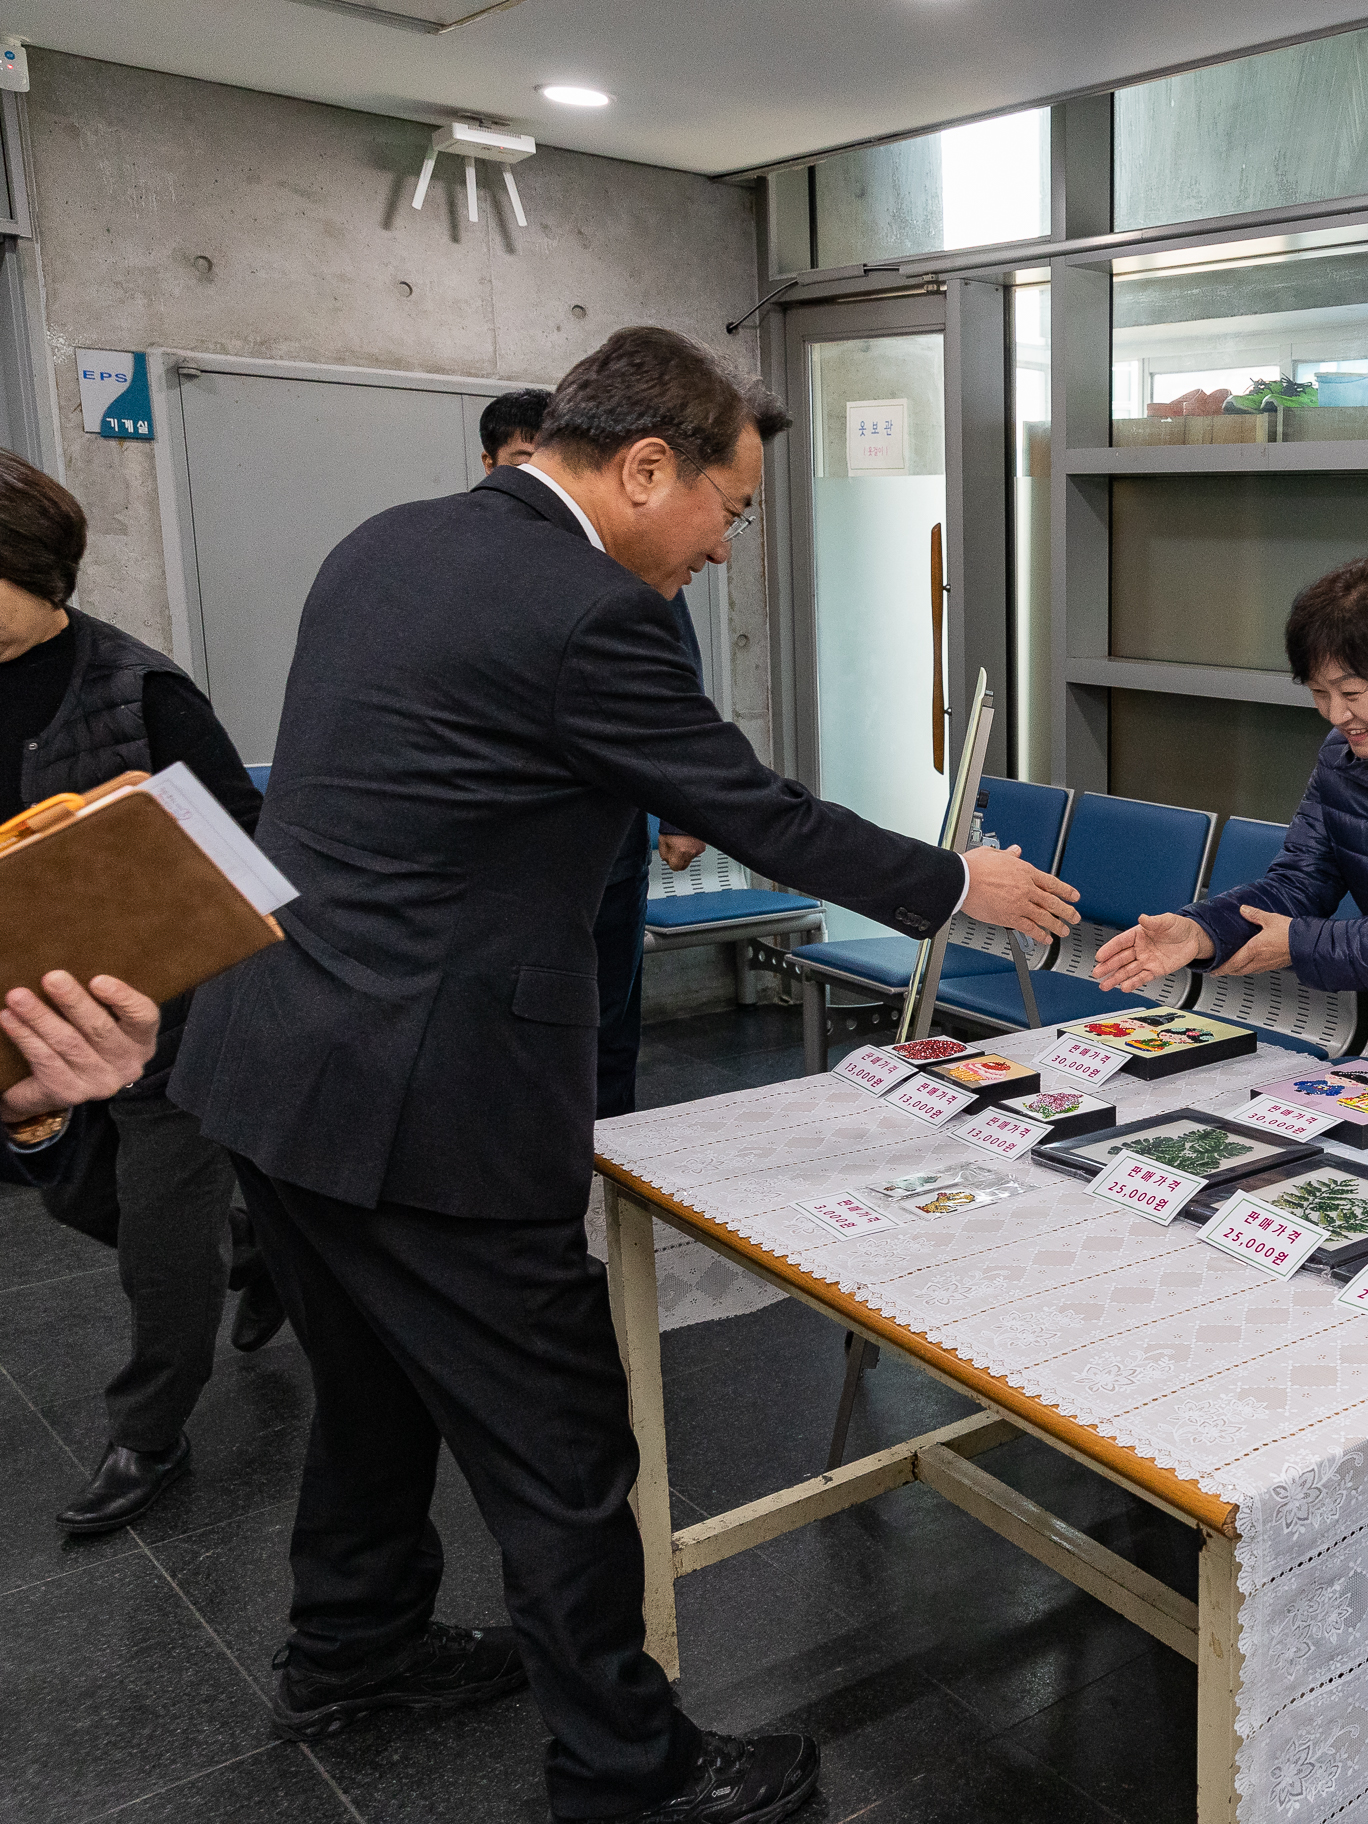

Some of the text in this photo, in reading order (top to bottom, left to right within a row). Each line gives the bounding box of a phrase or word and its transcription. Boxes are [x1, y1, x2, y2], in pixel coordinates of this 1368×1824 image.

[83, 370, 128, 383] EPS
[106, 418, 149, 434] 기계실
[859, 420, 893, 437] 옷보관
[1068, 1044, 1111, 1064] 판매가격
[844, 1063, 884, 1087] 13,000원
[1051, 1055, 1101, 1078] 30,000원
[917, 1083, 958, 1105] 판매가격
[899, 1094, 944, 1119] 13,000원
[1267, 1105, 1319, 1124] 판매가격
[986, 1117, 1031, 1138] 판매가격
[1248, 1113, 1307, 1134] 30,000원
[967, 1128, 1017, 1152] 13,000원
[1127, 1166, 1182, 1192] 판매가격
[1108, 1181, 1169, 1212] 25,000원
[814, 1204, 858, 1228] 3,000원
[1244, 1211, 1302, 1244] 판매가격
[1223, 1227, 1289, 1266] 25,000원
